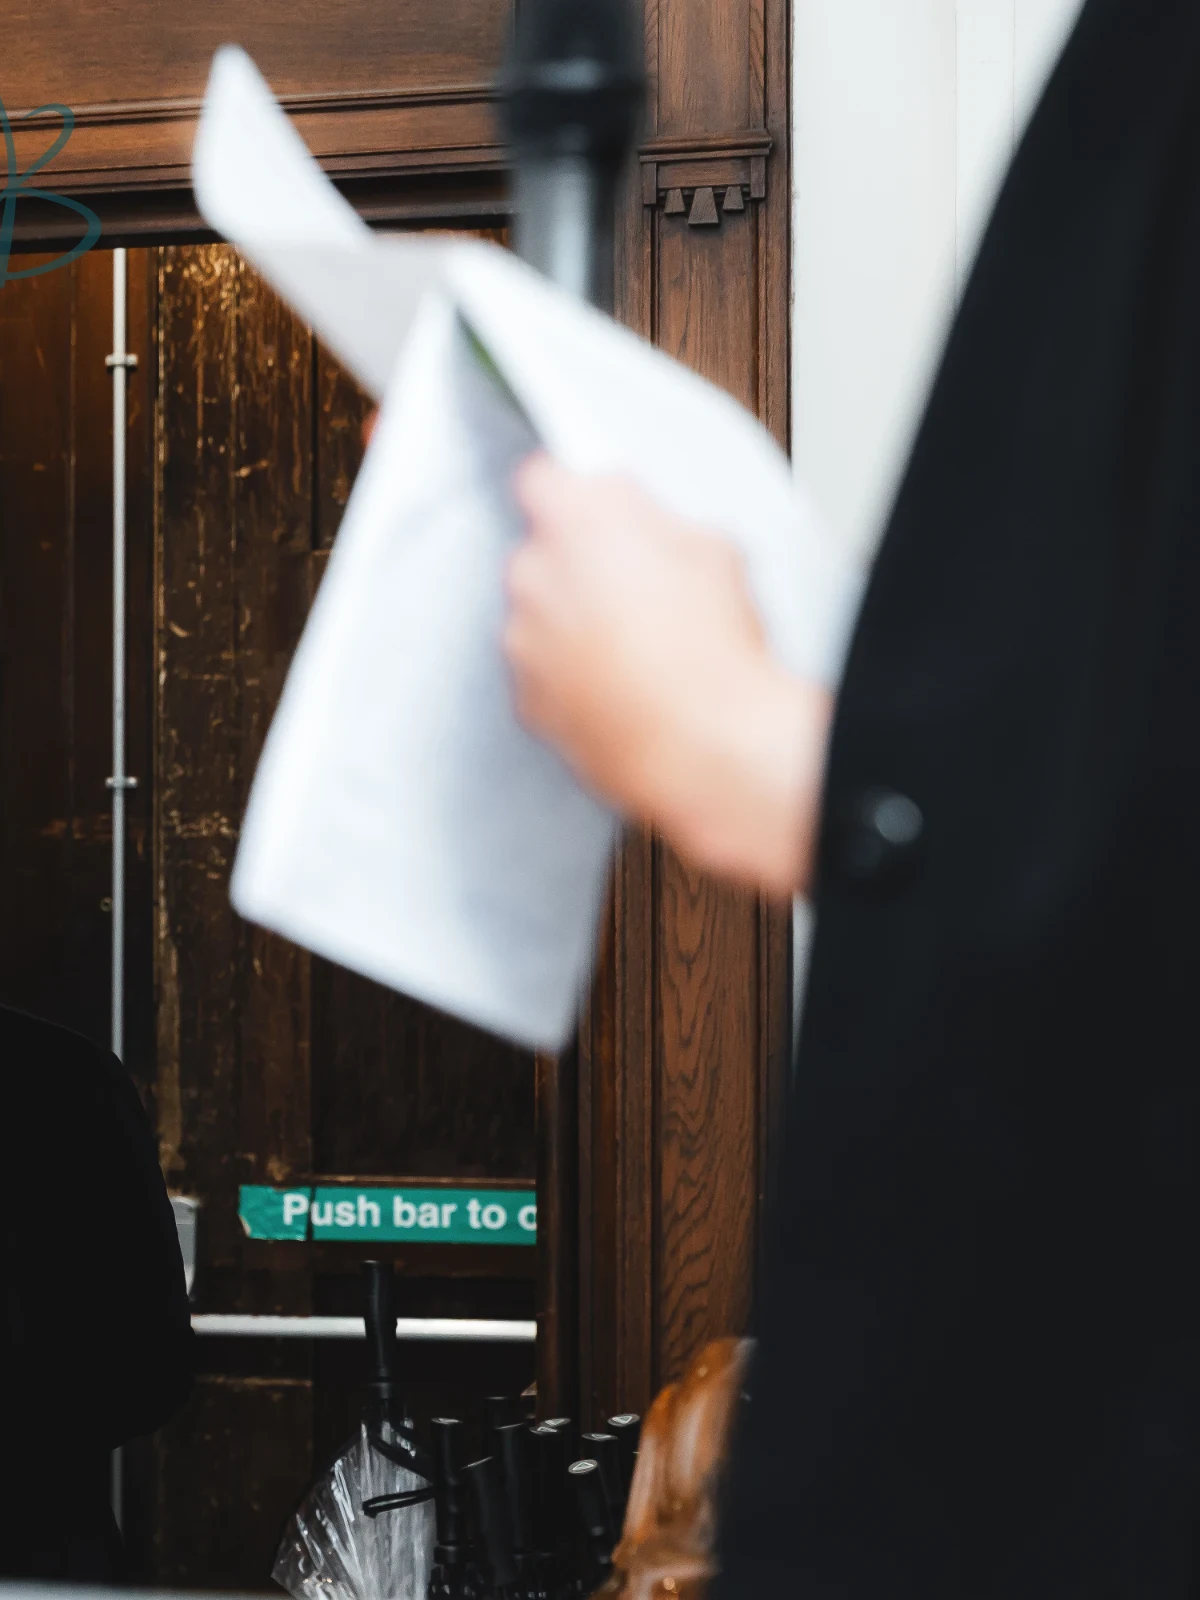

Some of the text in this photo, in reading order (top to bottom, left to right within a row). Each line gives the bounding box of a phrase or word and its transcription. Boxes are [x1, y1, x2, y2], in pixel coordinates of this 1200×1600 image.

[283, 1193, 381, 1227] Push
[393, 1195, 457, 1228] bar
[467, 1198, 507, 1230] to
